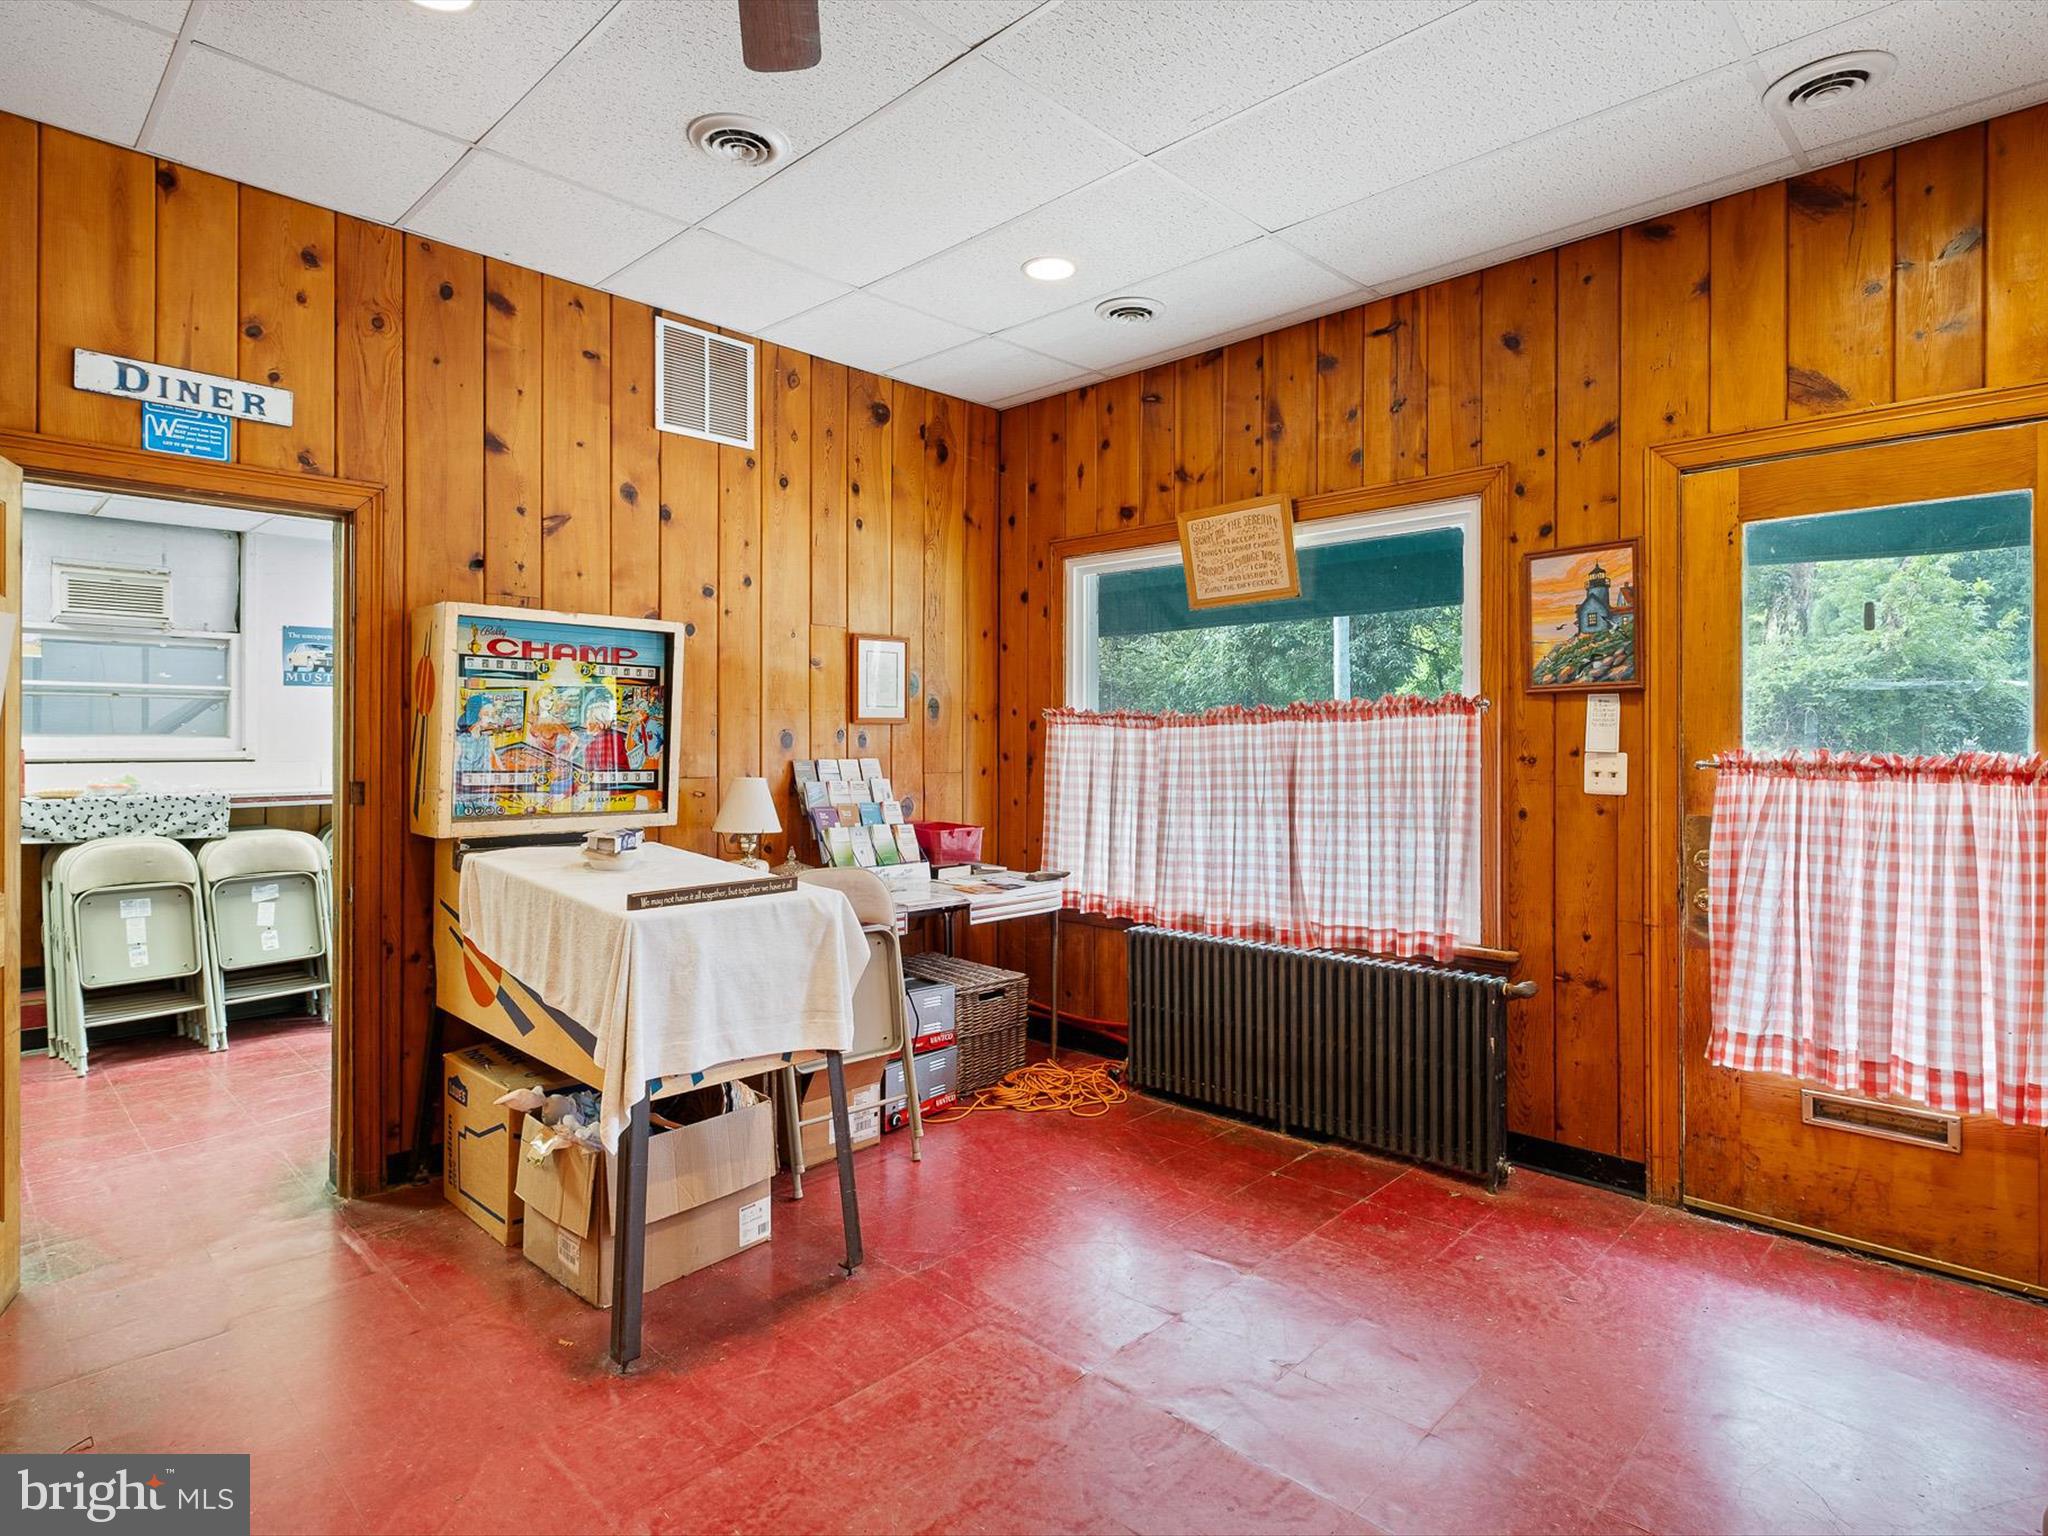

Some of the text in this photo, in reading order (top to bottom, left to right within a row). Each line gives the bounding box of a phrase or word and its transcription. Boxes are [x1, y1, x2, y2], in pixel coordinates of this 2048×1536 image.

[114, 361, 266, 416] DINER
[487, 638, 638, 664] CHAMP
[651, 899, 663, 907] may
[664, 896, 674, 904] not
[675, 893, 689, 902] have
[739, 884, 760, 897] together
[770, 882, 781, 891] have
